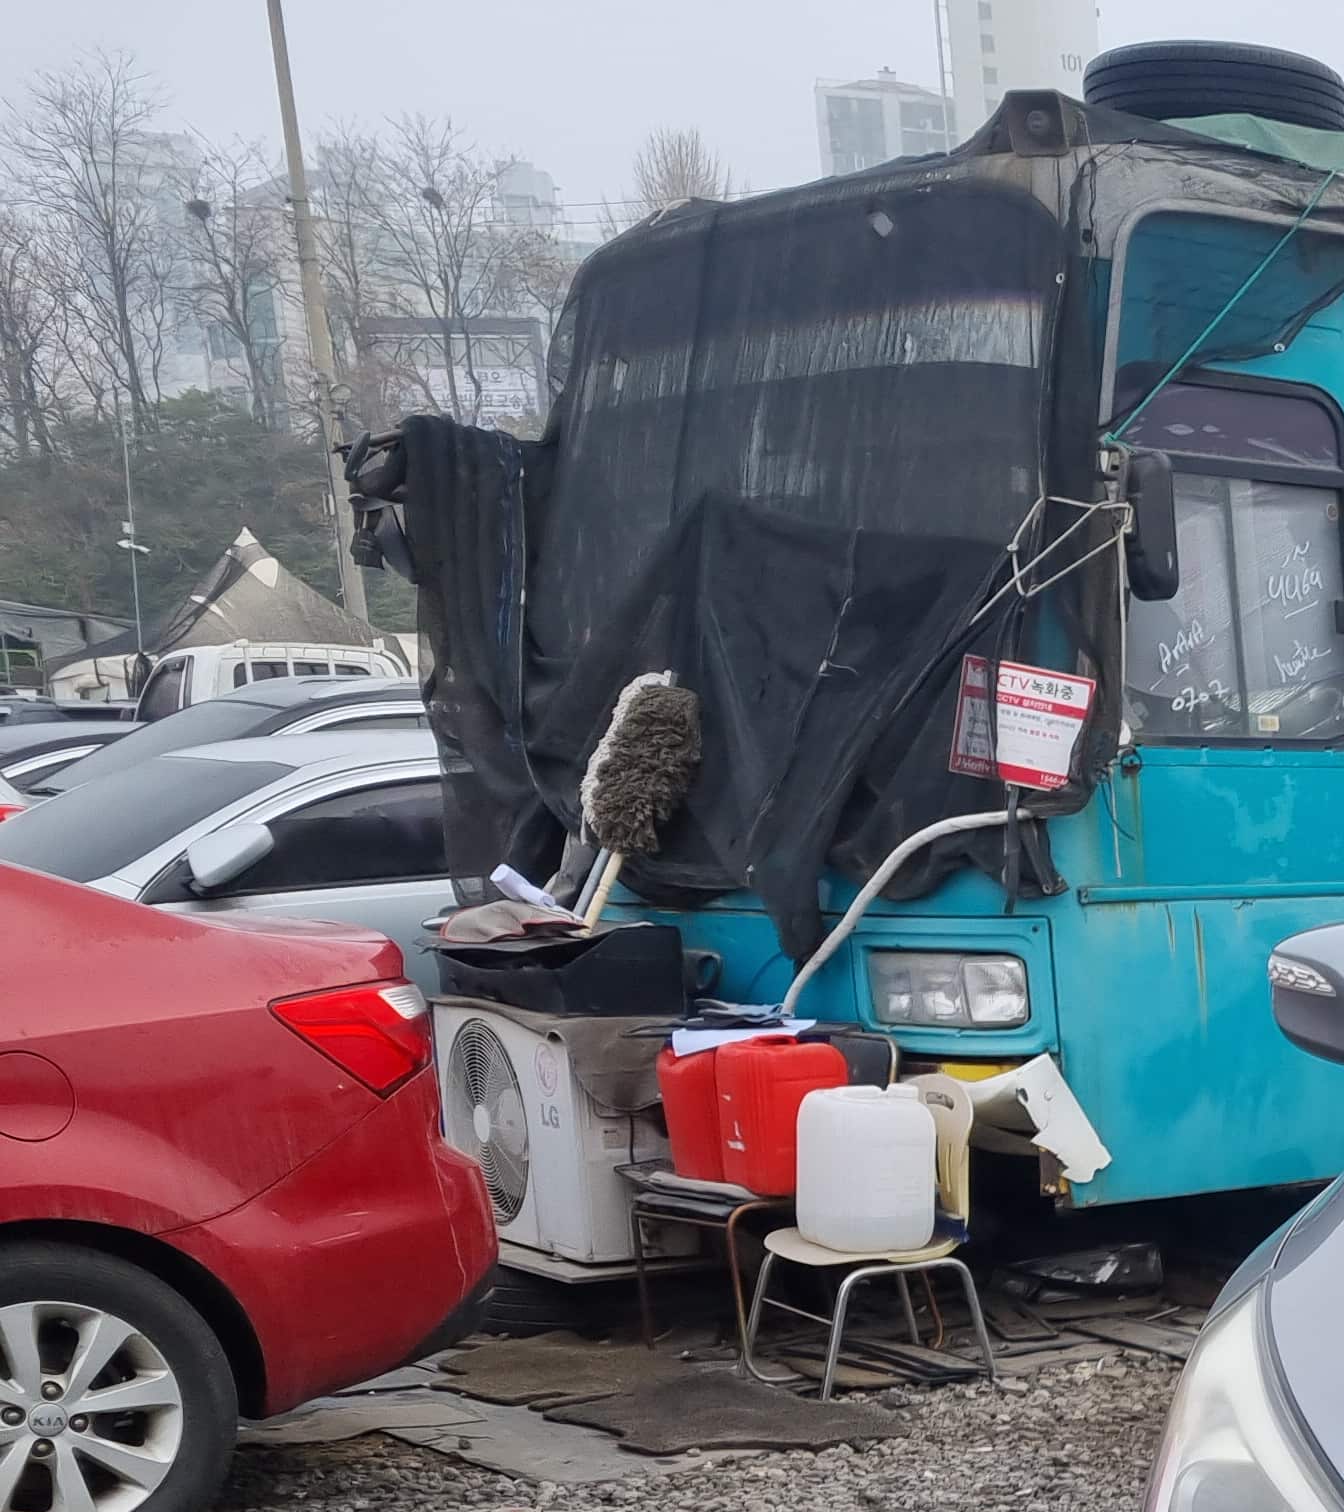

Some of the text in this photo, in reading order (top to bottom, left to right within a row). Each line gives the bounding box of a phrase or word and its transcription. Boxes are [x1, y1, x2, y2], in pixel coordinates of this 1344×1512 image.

[1061, 53, 1082, 72] 101
[540, 1103, 560, 1128] LG
[33, 1416, 64, 1426] KIA
